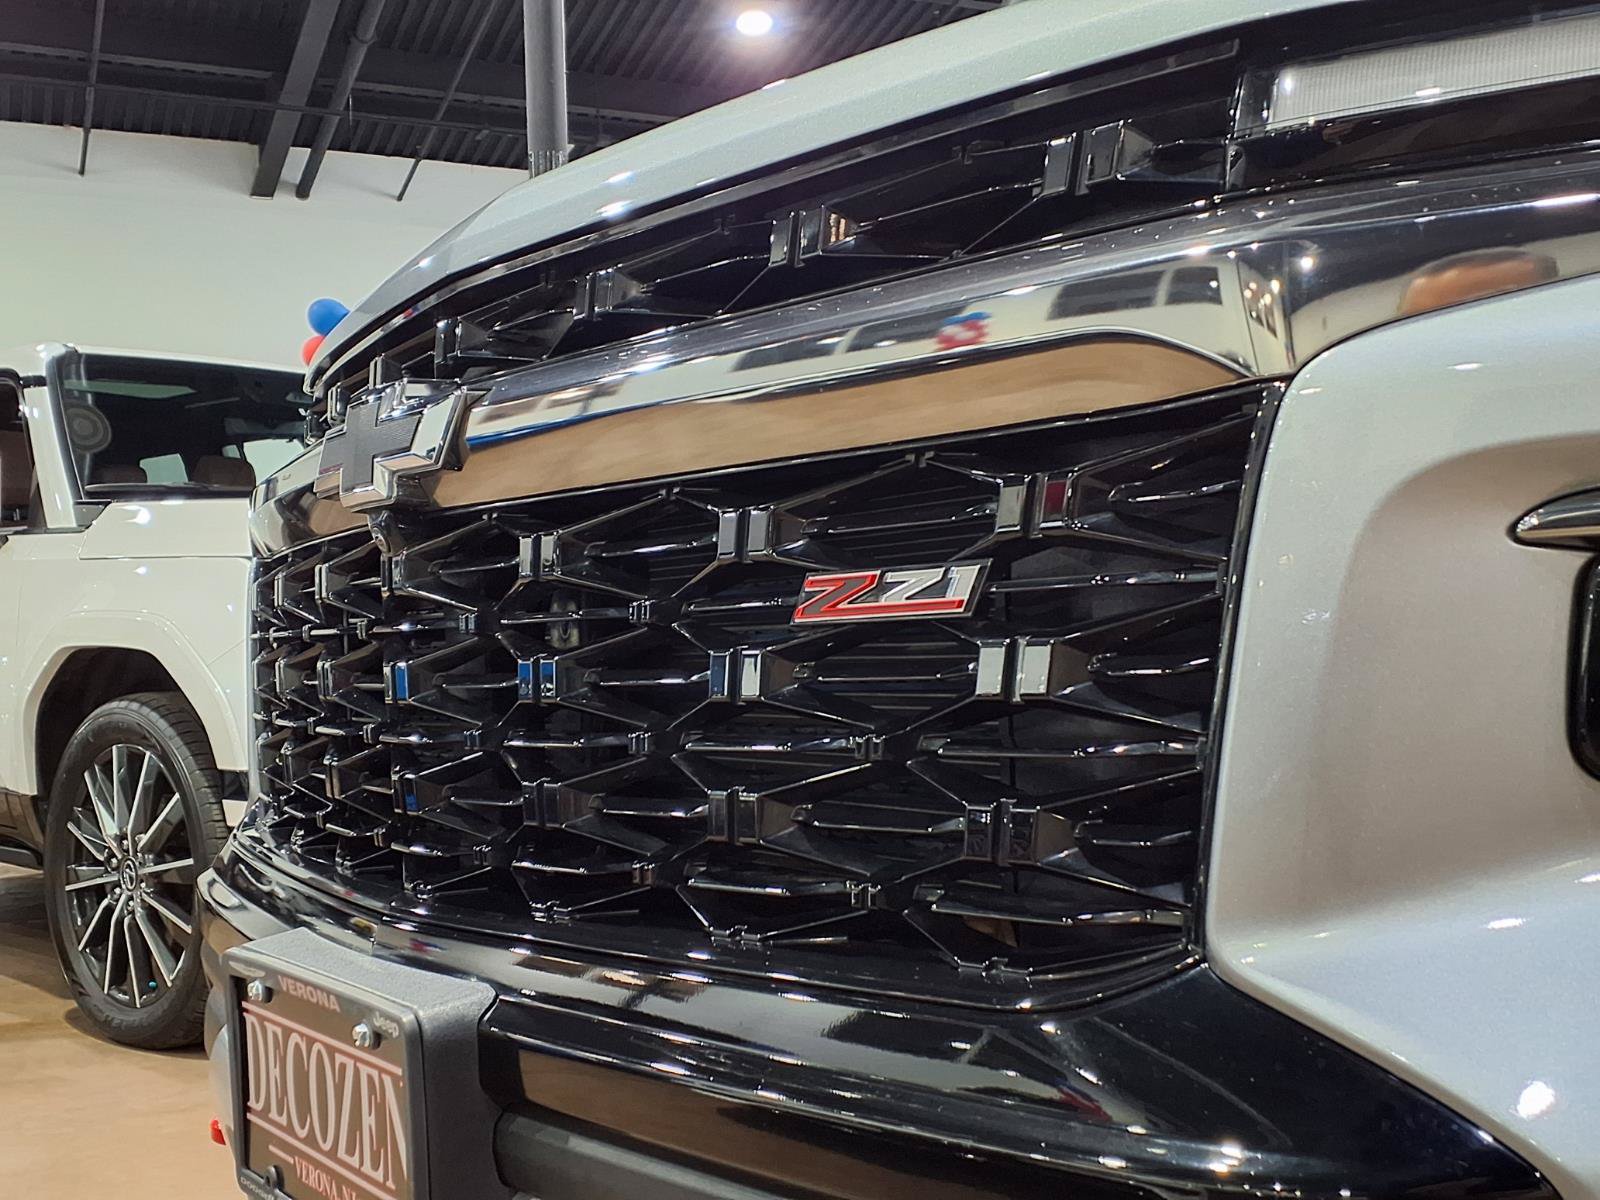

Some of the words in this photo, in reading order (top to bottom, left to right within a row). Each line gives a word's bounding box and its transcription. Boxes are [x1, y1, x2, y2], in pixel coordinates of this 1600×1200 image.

[793, 565, 980, 622] Z71
[278, 975, 341, 1012] VERONA
[243, 1012, 407, 1190] DECOZEN
